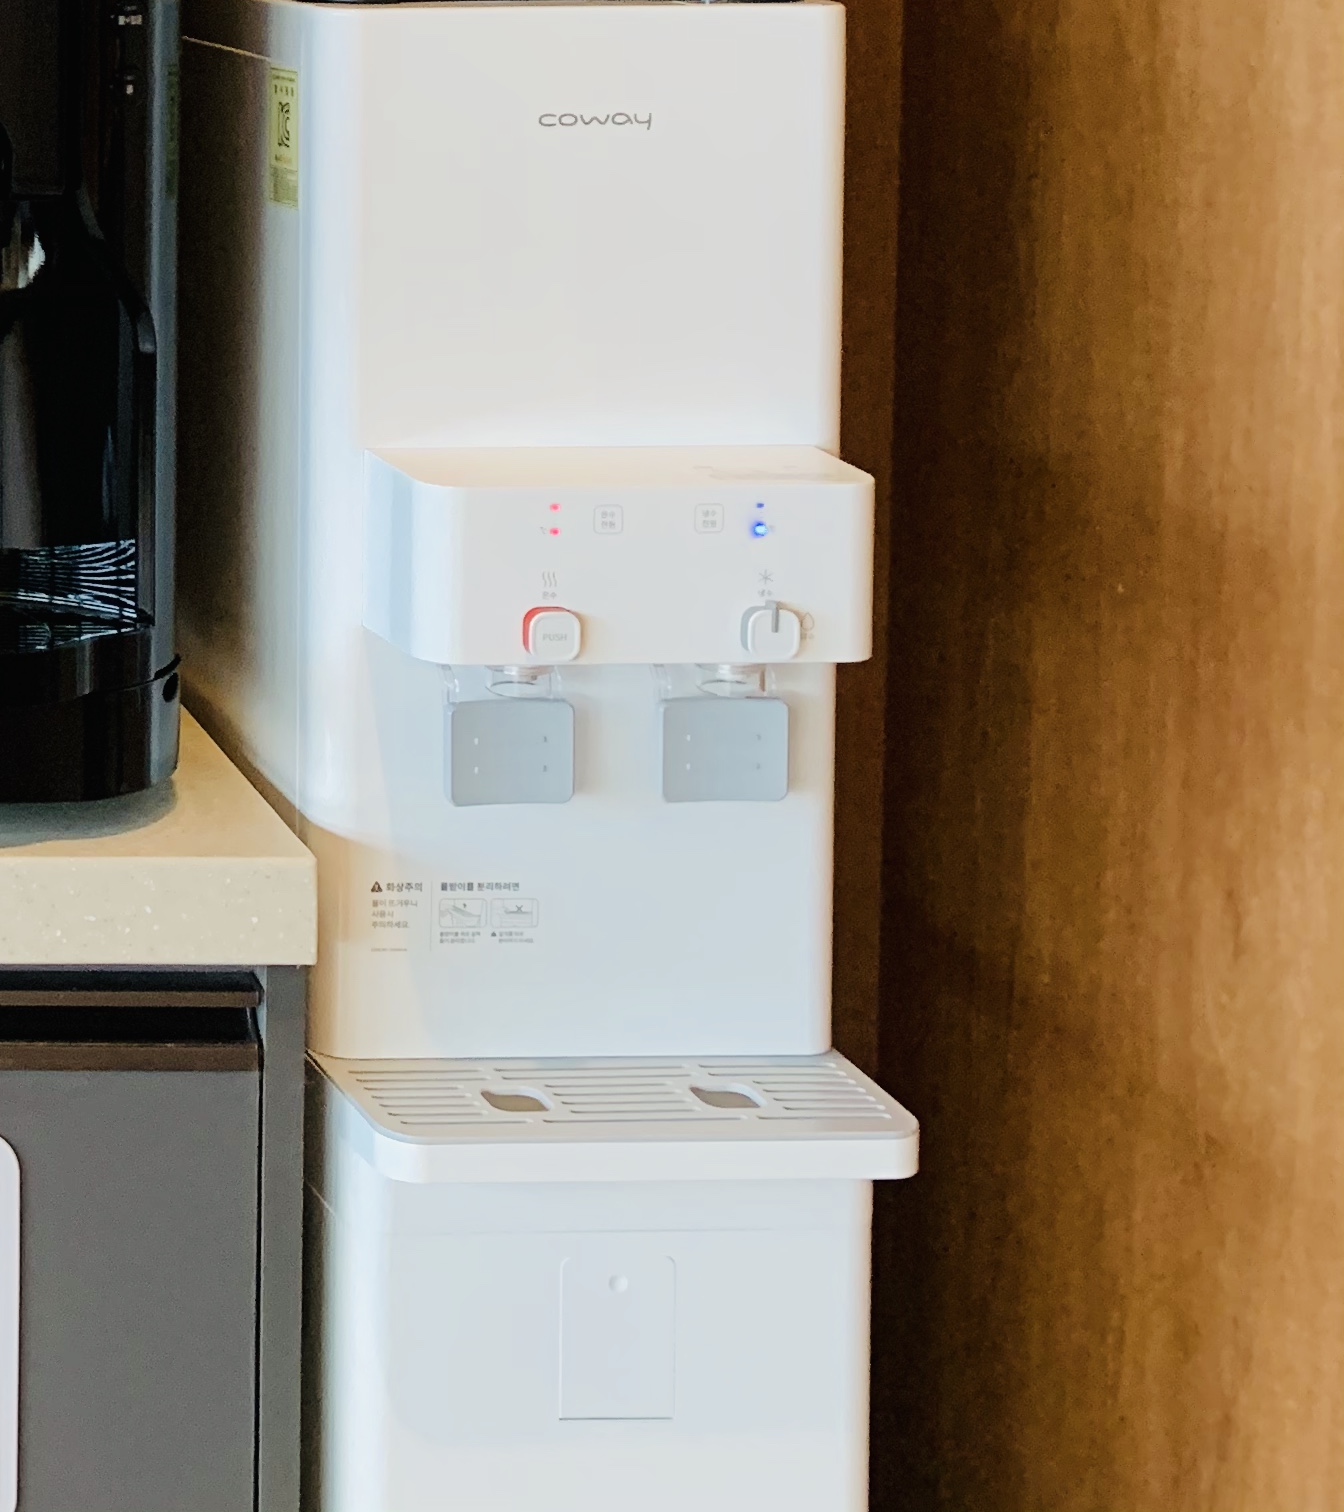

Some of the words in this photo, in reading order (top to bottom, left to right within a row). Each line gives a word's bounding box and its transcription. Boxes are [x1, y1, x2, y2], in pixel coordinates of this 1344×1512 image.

[538, 112, 652, 130] coway
[542, 633, 568, 642] PUSH
[386, 882, 423, 892] 화상주의
